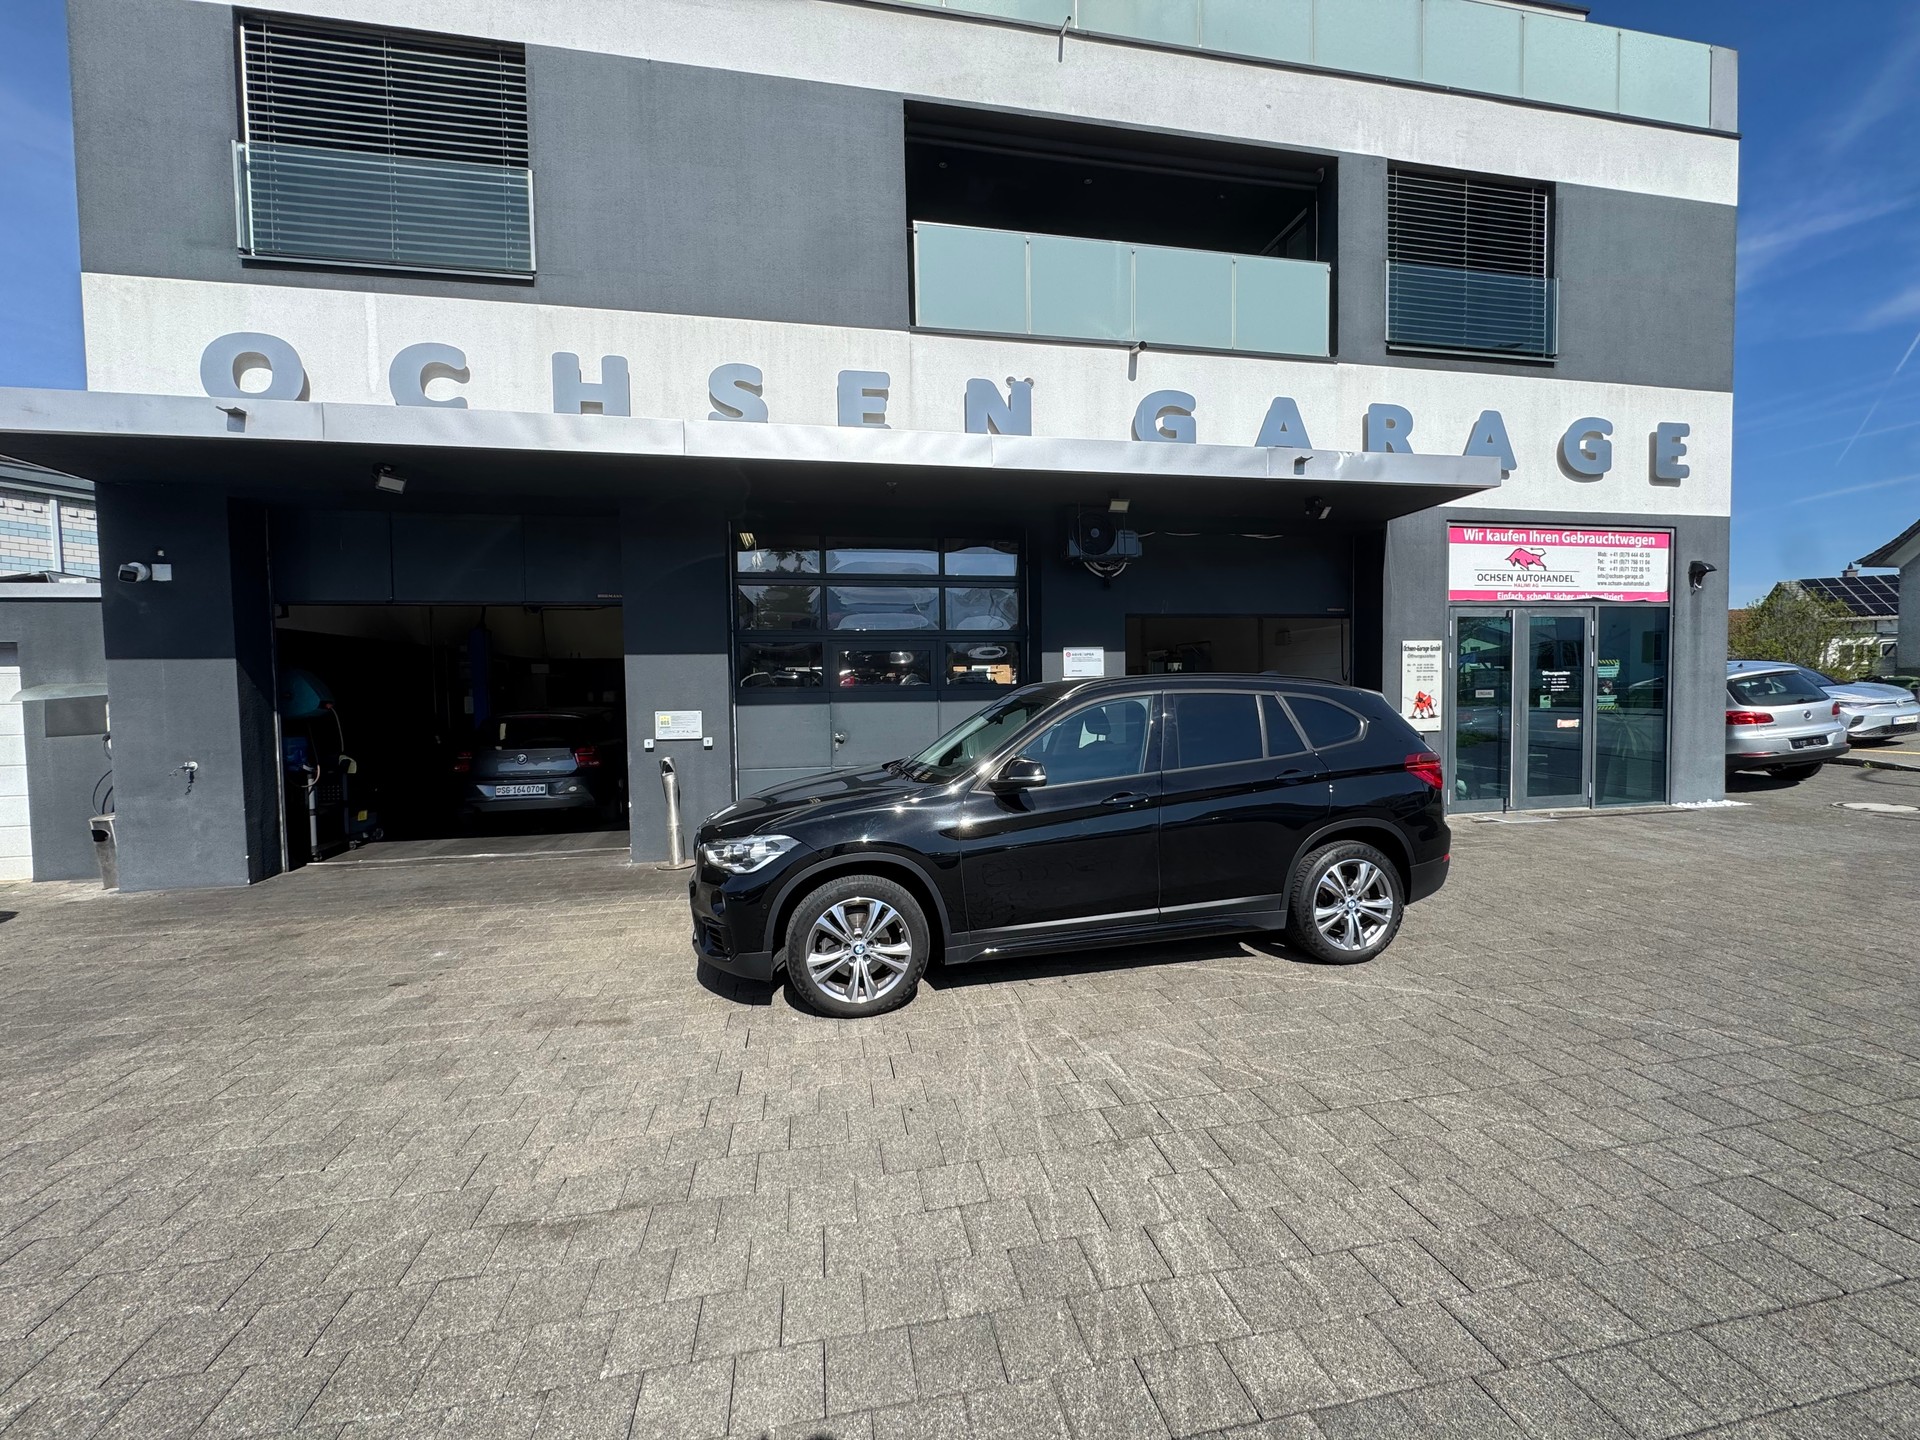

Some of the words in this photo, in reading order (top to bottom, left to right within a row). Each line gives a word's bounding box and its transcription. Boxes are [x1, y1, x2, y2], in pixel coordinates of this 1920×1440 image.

[200, 331, 1032, 436] OCHSEN
[1135, 389, 1691, 480] GARAGE
[1463, 529, 1484, 541] Wir
[1486, 529, 1528, 543] kaufen
[1529, 531, 1559, 544] Ihren
[1562, 531, 1655, 548] Gebrauchtwagen
[1477, 572, 1514, 582] OCHSEN
[1516, 573, 1575, 583] AUTOHANDEL
